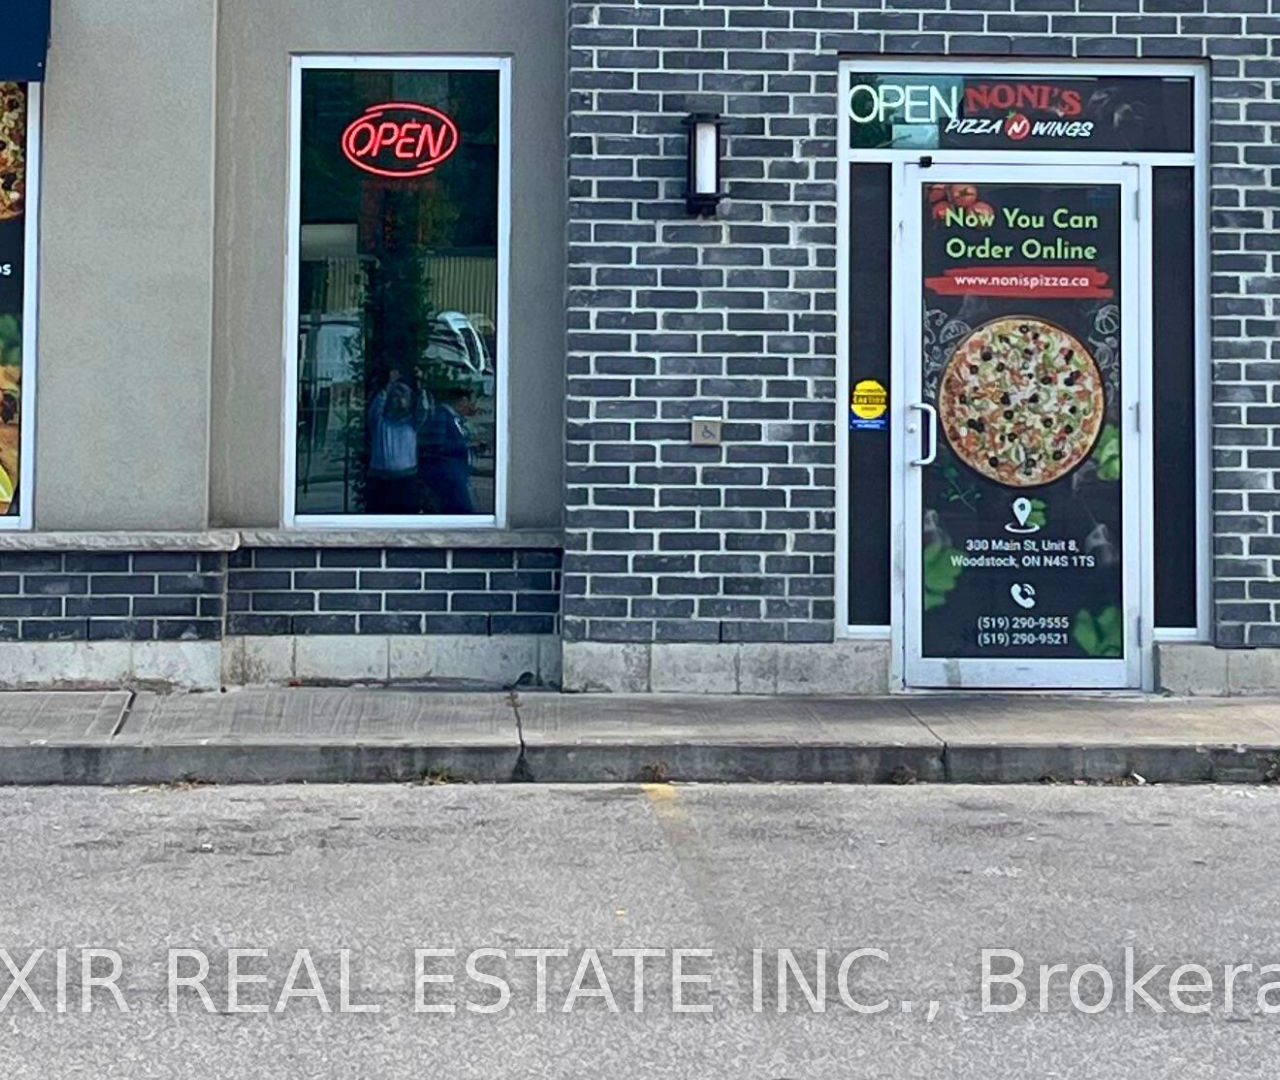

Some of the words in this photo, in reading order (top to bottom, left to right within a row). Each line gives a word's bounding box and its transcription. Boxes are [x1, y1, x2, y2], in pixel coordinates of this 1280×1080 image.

[849, 84, 958, 124] OPEN
[963, 83, 1082, 117] NONI'S
[945, 118, 1004, 134] PIZZA
[1032, 120, 1094, 137] WINGS
[348, 120, 446, 159] OPEN
[945, 207, 996, 228] Now
[1002, 207, 1045, 228] You
[1052, 207, 1099, 229] Can
[946, 237, 1013, 259] Order
[1021, 237, 1098, 260] Online
[954, 273, 1090, 289] www.nonispizza.ca
[991, 539, 1021, 551] Main
[1041, 539, 1066, 551] Unit
[950, 555, 1021, 569] Woodstock,
[1022, 556, 1041, 567] ON
[1043, 556, 1069, 567] N4S
[977, 616, 1010, 631] (519)
[1012, 617, 1069, 629] 290-9555
[977, 632, 1010, 647] (519)
[1012, 633, 1069, 645] 290-9521
